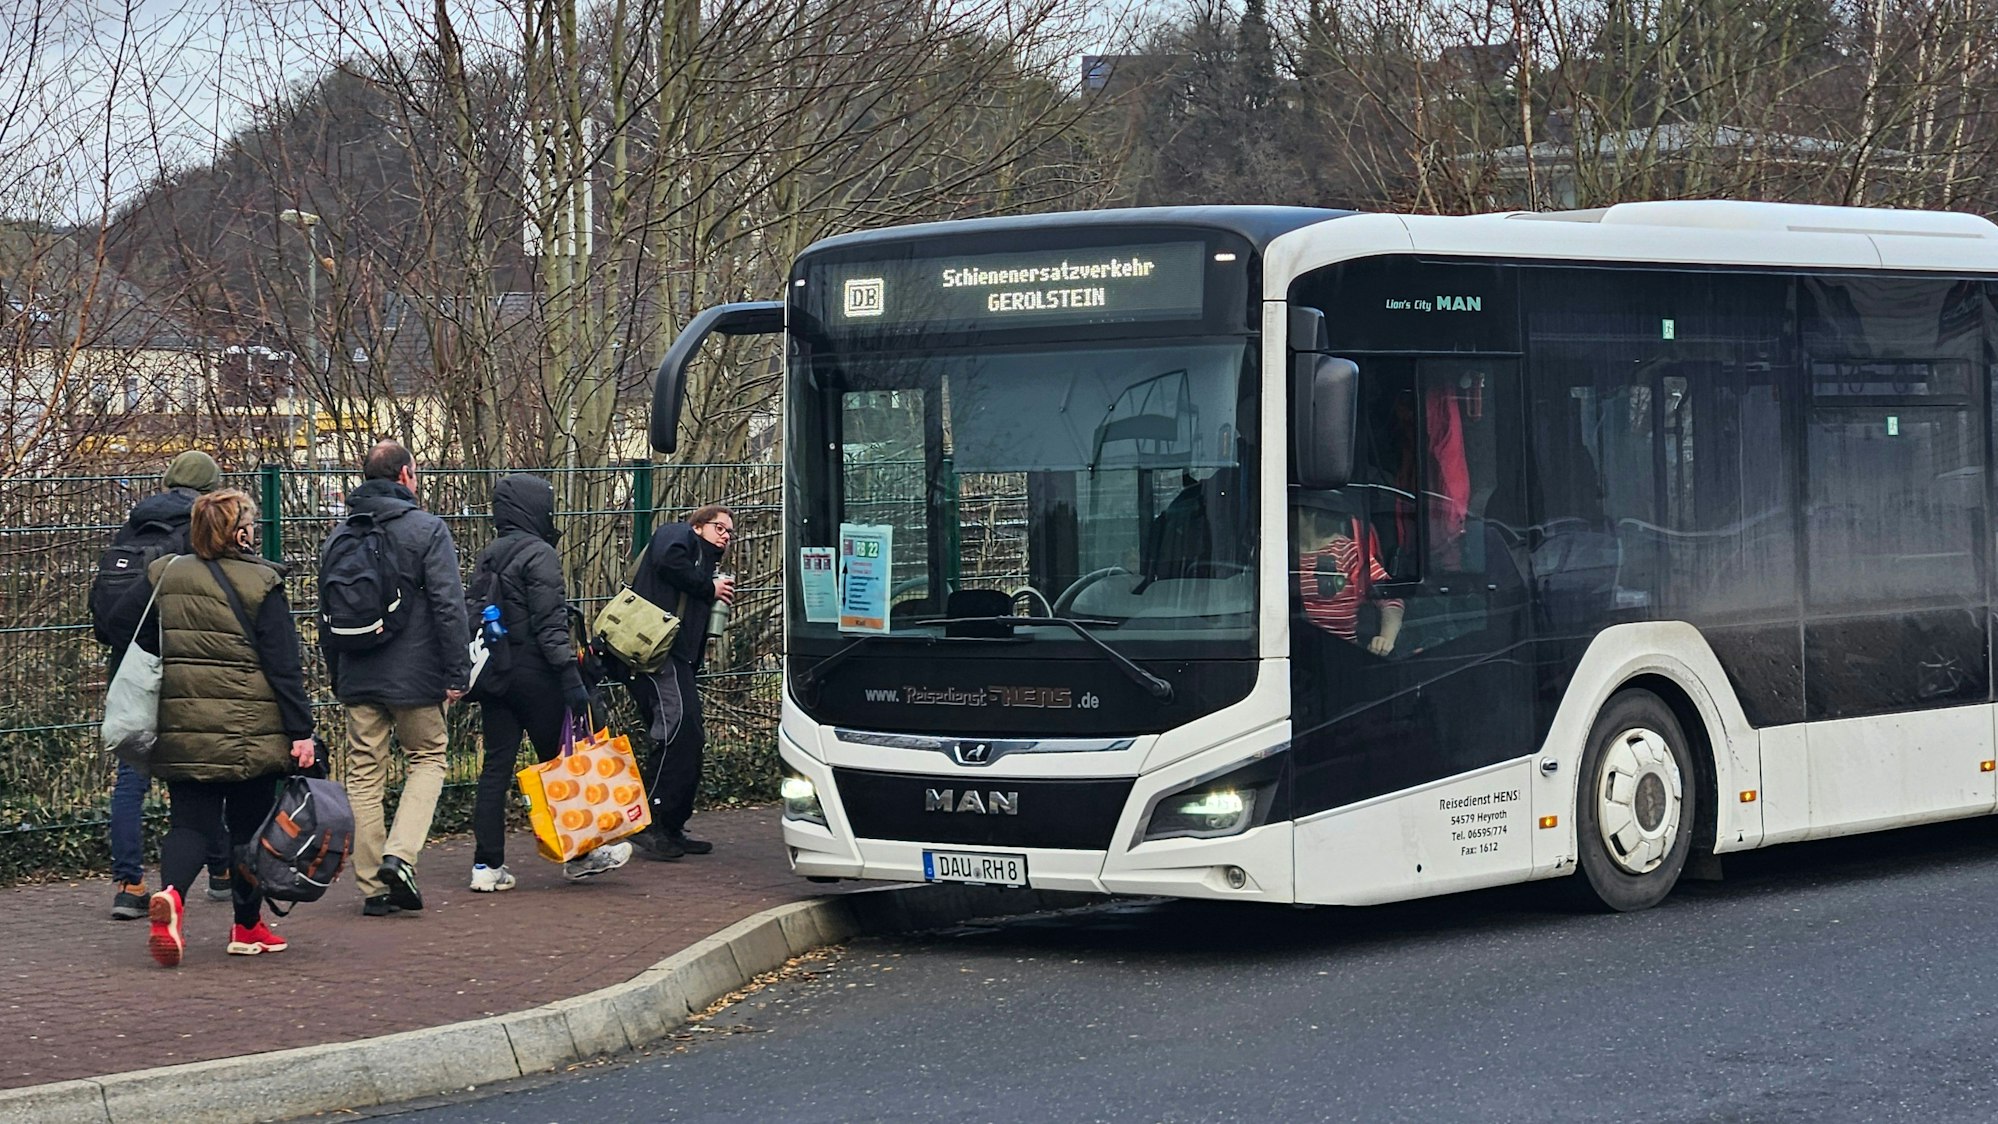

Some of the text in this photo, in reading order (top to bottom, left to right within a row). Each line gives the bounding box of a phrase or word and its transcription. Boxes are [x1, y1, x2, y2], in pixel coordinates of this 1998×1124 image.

[942, 257, 1155, 287] Schienenersatzverkehr
[851, 287, 877, 307] DB
[987, 286, 1105, 312] GEROLSTEIN
[1386, 295, 1481, 312] Lion's City MAN
[868, 542, 878, 557] 22
[865, 689, 900, 703] www.
[925, 788, 1018, 815] MAN
[1439, 789, 1518, 810] Reisedienst HENS
[1451, 810, 1507, 825] 54579 Heyroth
[1452, 825, 1507, 841] Tel. 06595/774
[1461, 842, 1498, 856] Fax: 1612
[939, 856, 972, 877] DAU
[983, 859, 1004, 880] RH
[1008, 861, 1018, 881] 8
